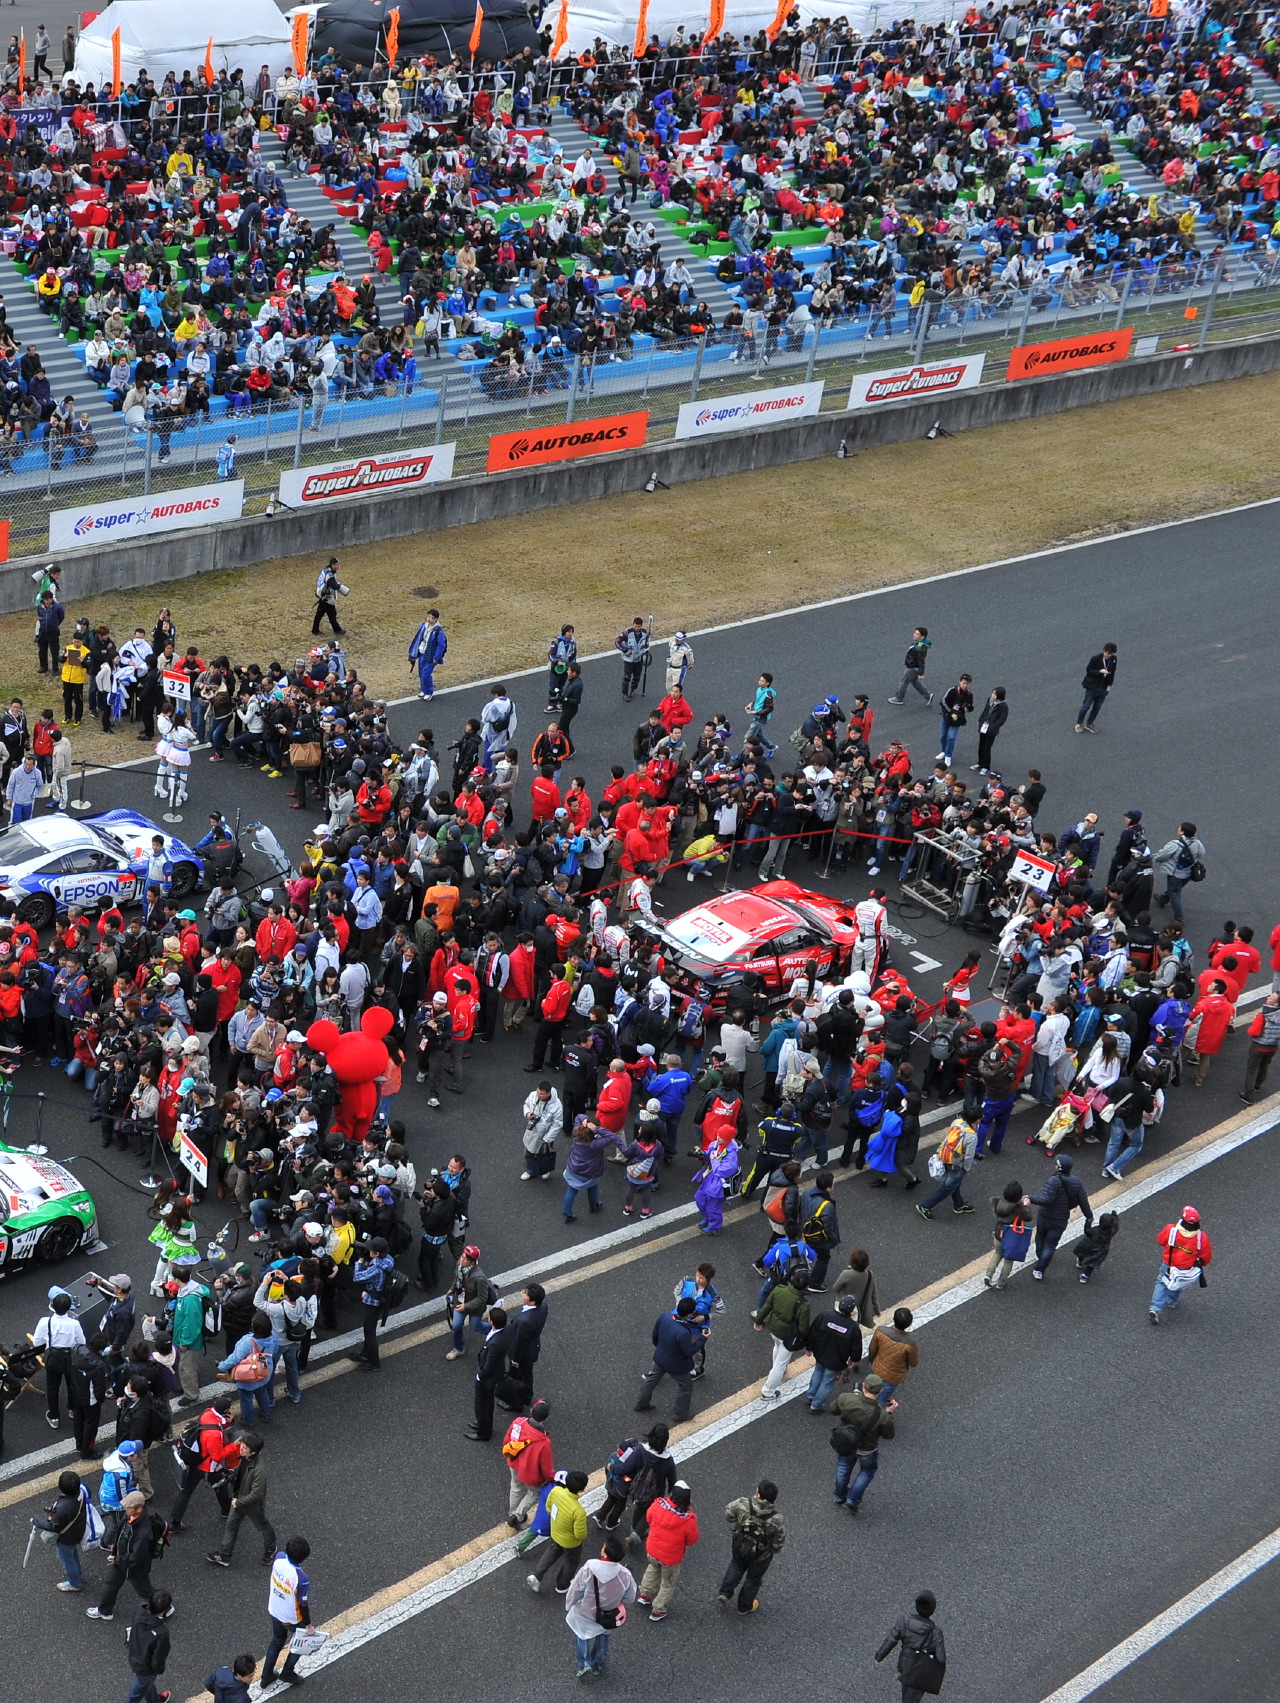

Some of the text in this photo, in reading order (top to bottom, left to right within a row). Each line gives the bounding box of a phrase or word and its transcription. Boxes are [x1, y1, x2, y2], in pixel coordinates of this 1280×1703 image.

[10, 112, 53, 122] ンタレッリ
[1039, 341, 1117, 363] AUTOBACS
[752, 396, 805, 414] AUTOBACS
[529, 426, 629, 453] AUTOBACS
[150, 497, 221, 520] AUTOBACS
[168, 680, 185, 694] 32
[77, 875, 102, 885] HONDA
[1020, 863, 1045, 881] 23
[63, 880, 119, 903] EPSON
[120, 881, 133, 890] 32
[634, 919, 703, 961] NISSAN
[694, 918, 732, 943] MOTUL
[700, 931, 723, 946] TECH
[185, 1149, 202, 1172] 24
